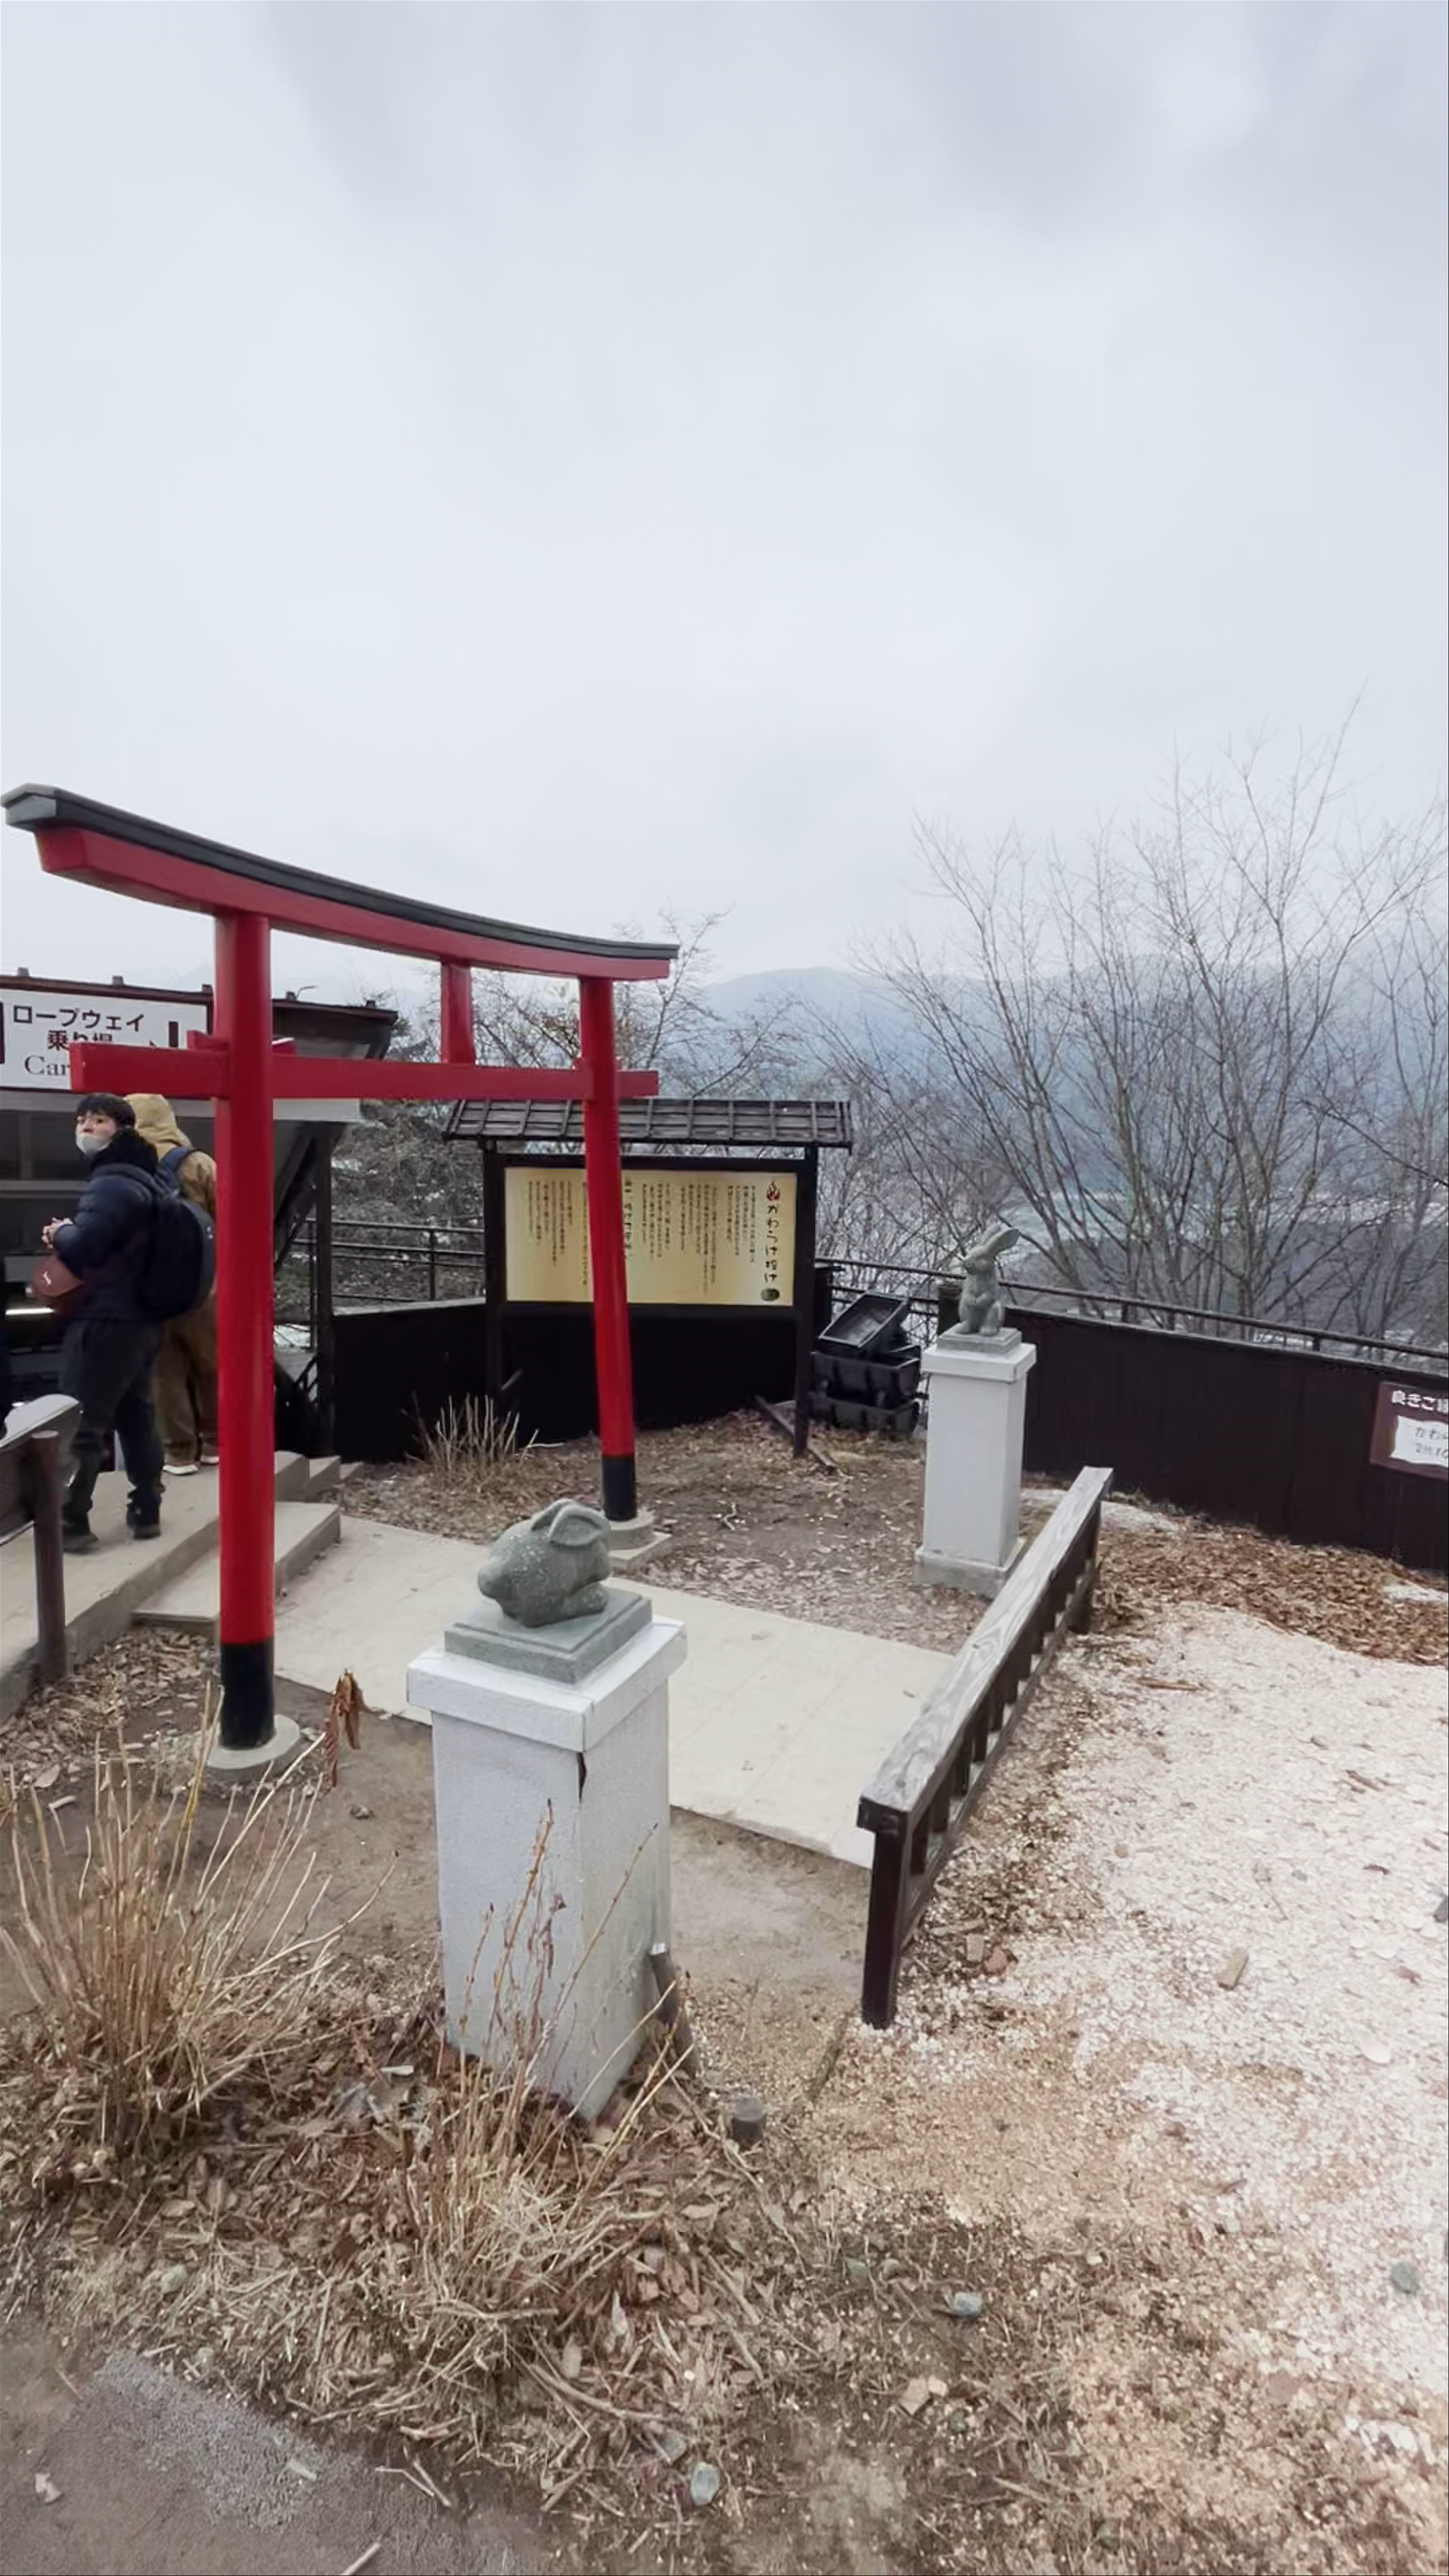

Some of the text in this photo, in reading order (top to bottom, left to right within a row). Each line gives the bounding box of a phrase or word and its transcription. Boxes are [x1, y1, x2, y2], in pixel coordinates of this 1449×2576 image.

[14, 1005, 144, 1032] ロープウェイ
